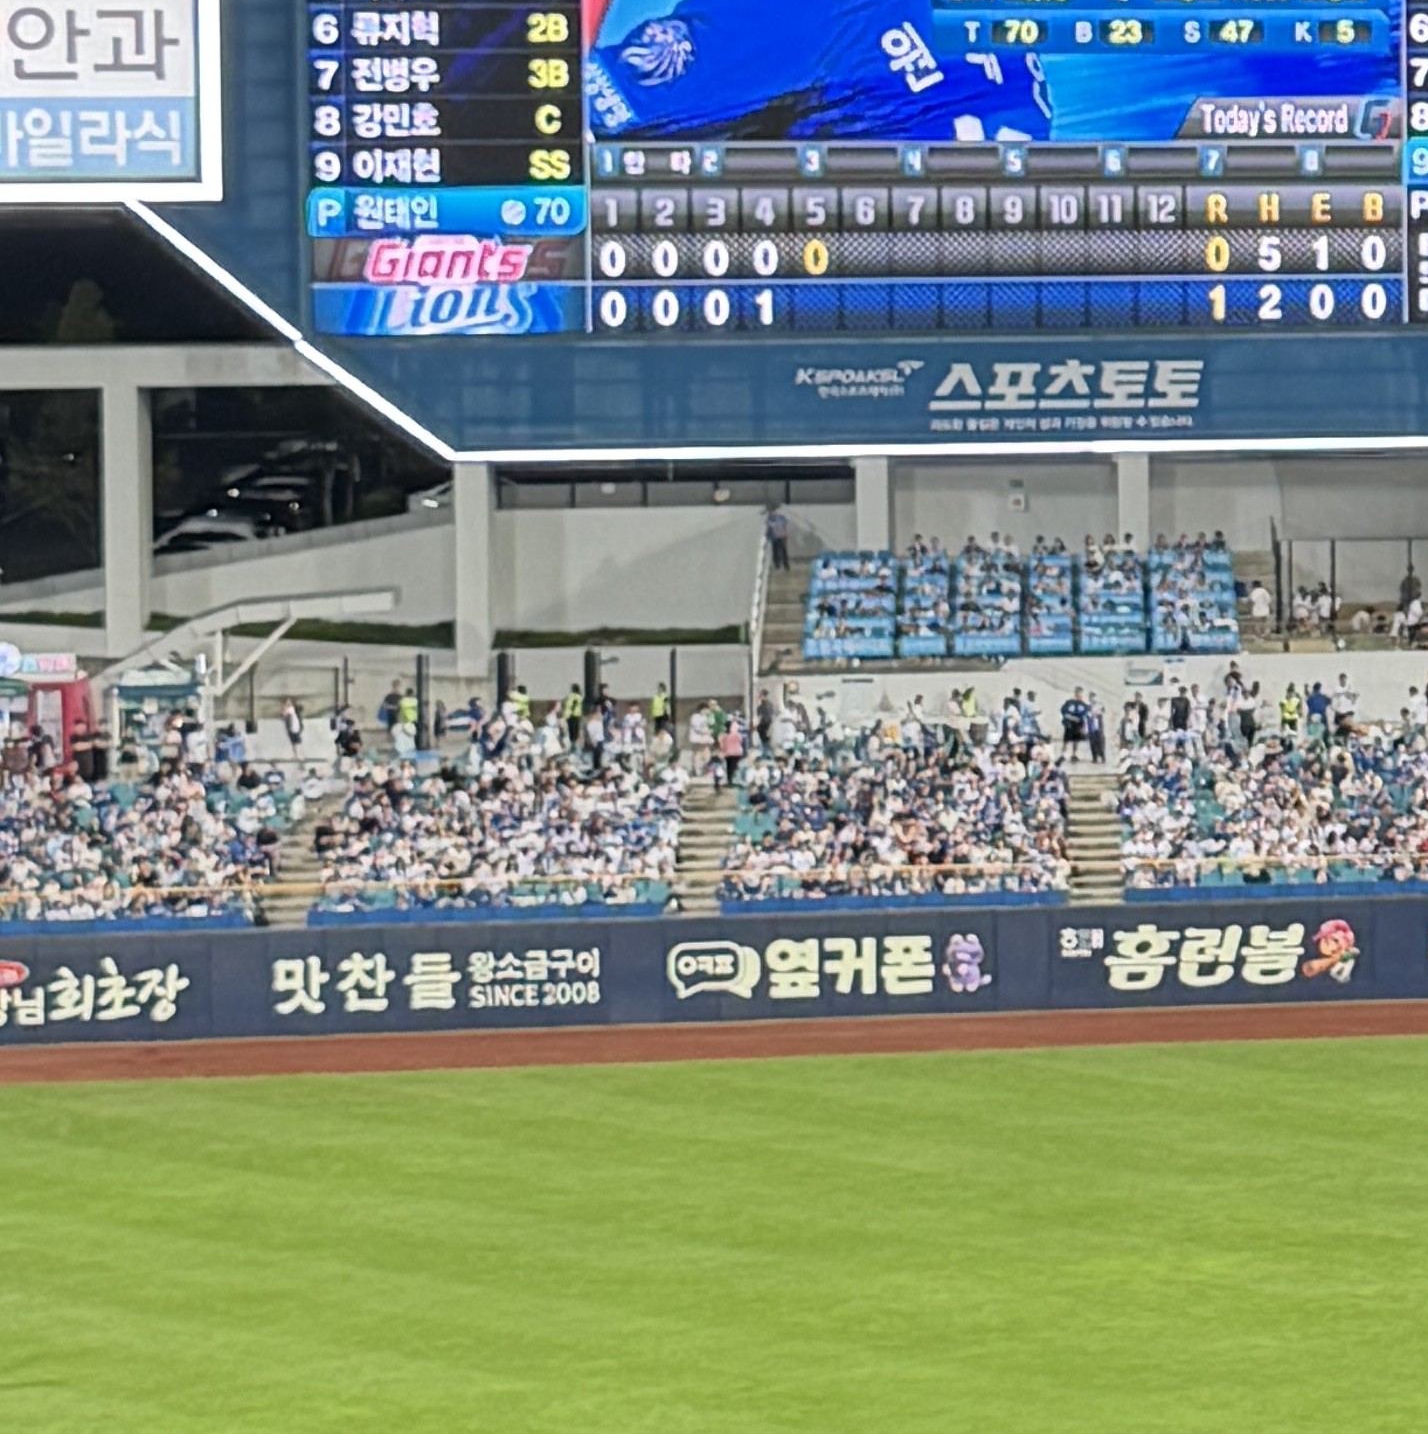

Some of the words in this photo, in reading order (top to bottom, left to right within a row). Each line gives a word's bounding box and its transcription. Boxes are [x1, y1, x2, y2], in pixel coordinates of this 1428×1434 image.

[7, 6, 180, 80] 안과
[526, 13, 569, 43] 2B
[963, 21, 980, 43] T
[1005, 21, 1039, 44] 70
[1075, 21, 1093, 44] B
[1108, 20, 1143, 44] 23
[1184, 20, 1201, 43] S
[1219, 20, 1254, 44] 47
[1295, 20, 1312, 43] K
[1335, 20, 1355, 43] 5
[528, 58, 569, 89] 3B
[534, 104, 562, 135] C
[1202, 101, 1278, 138] Today's
[1280, 102, 1349, 135] Record
[528, 149, 571, 180] SS
[317, 198, 342, 227] P
[353, 195, 438, 230] 원태인
[533, 197, 571, 226] 70
[605, 197, 618, 227] 1
[655, 197, 675, 227] 2
[706, 197, 726, 227] 3
[754, 197, 775, 226] 4
[806, 196, 826, 226] 5
[855, 196, 875, 226] 6
[908, 195, 925, 225] 7
[956, 195, 974, 225] 8
[1004, 195, 1023, 224] 9
[1049, 194, 1078, 224] 10
[1098, 194, 1123, 224] 11
[1147, 194, 1176, 224] 12
[1206, 193, 1228, 223] R
[1257, 193, 1280, 223] H
[1311, 193, 1331, 223] E
[1363, 193, 1384, 223] B
[366, 238, 531, 282] Giants
[600, 241, 626, 277] 0
[652, 240, 679, 277] 0
[703, 240, 730, 277] 0
[753, 239, 778, 276] 0
[803, 239, 829, 275] 0
[1205, 236, 1230, 272] 0
[1257, 236, 1282, 271] 5
[1312, 236, 1330, 271] 1
[1361, 235, 1387, 271] 0
[387, 285, 534, 332] Lions
[600, 290, 627, 327] 0
[652, 290, 679, 327] 0
[704, 289, 730, 326] 0
[755, 288, 774, 326] 1
[1208, 285, 1226, 322] 1
[1257, 285, 1283, 320] 2
[1309, 284, 1335, 319] 0
[1361, 283, 1387, 319] 0
[928, 359, 1204, 411] 스포츠토토
[468, 947, 601, 980] 왕소금구이
[765, 934, 936, 999] 옆커폰
[1104, 923, 1306, 991] 홈런볼
[48, 956, 191, 1022] 회초장
[272, 951, 462, 1014] 맛찬들
[468, 984, 540, 1009] SINCE
[541, 981, 601, 1007] 2008
